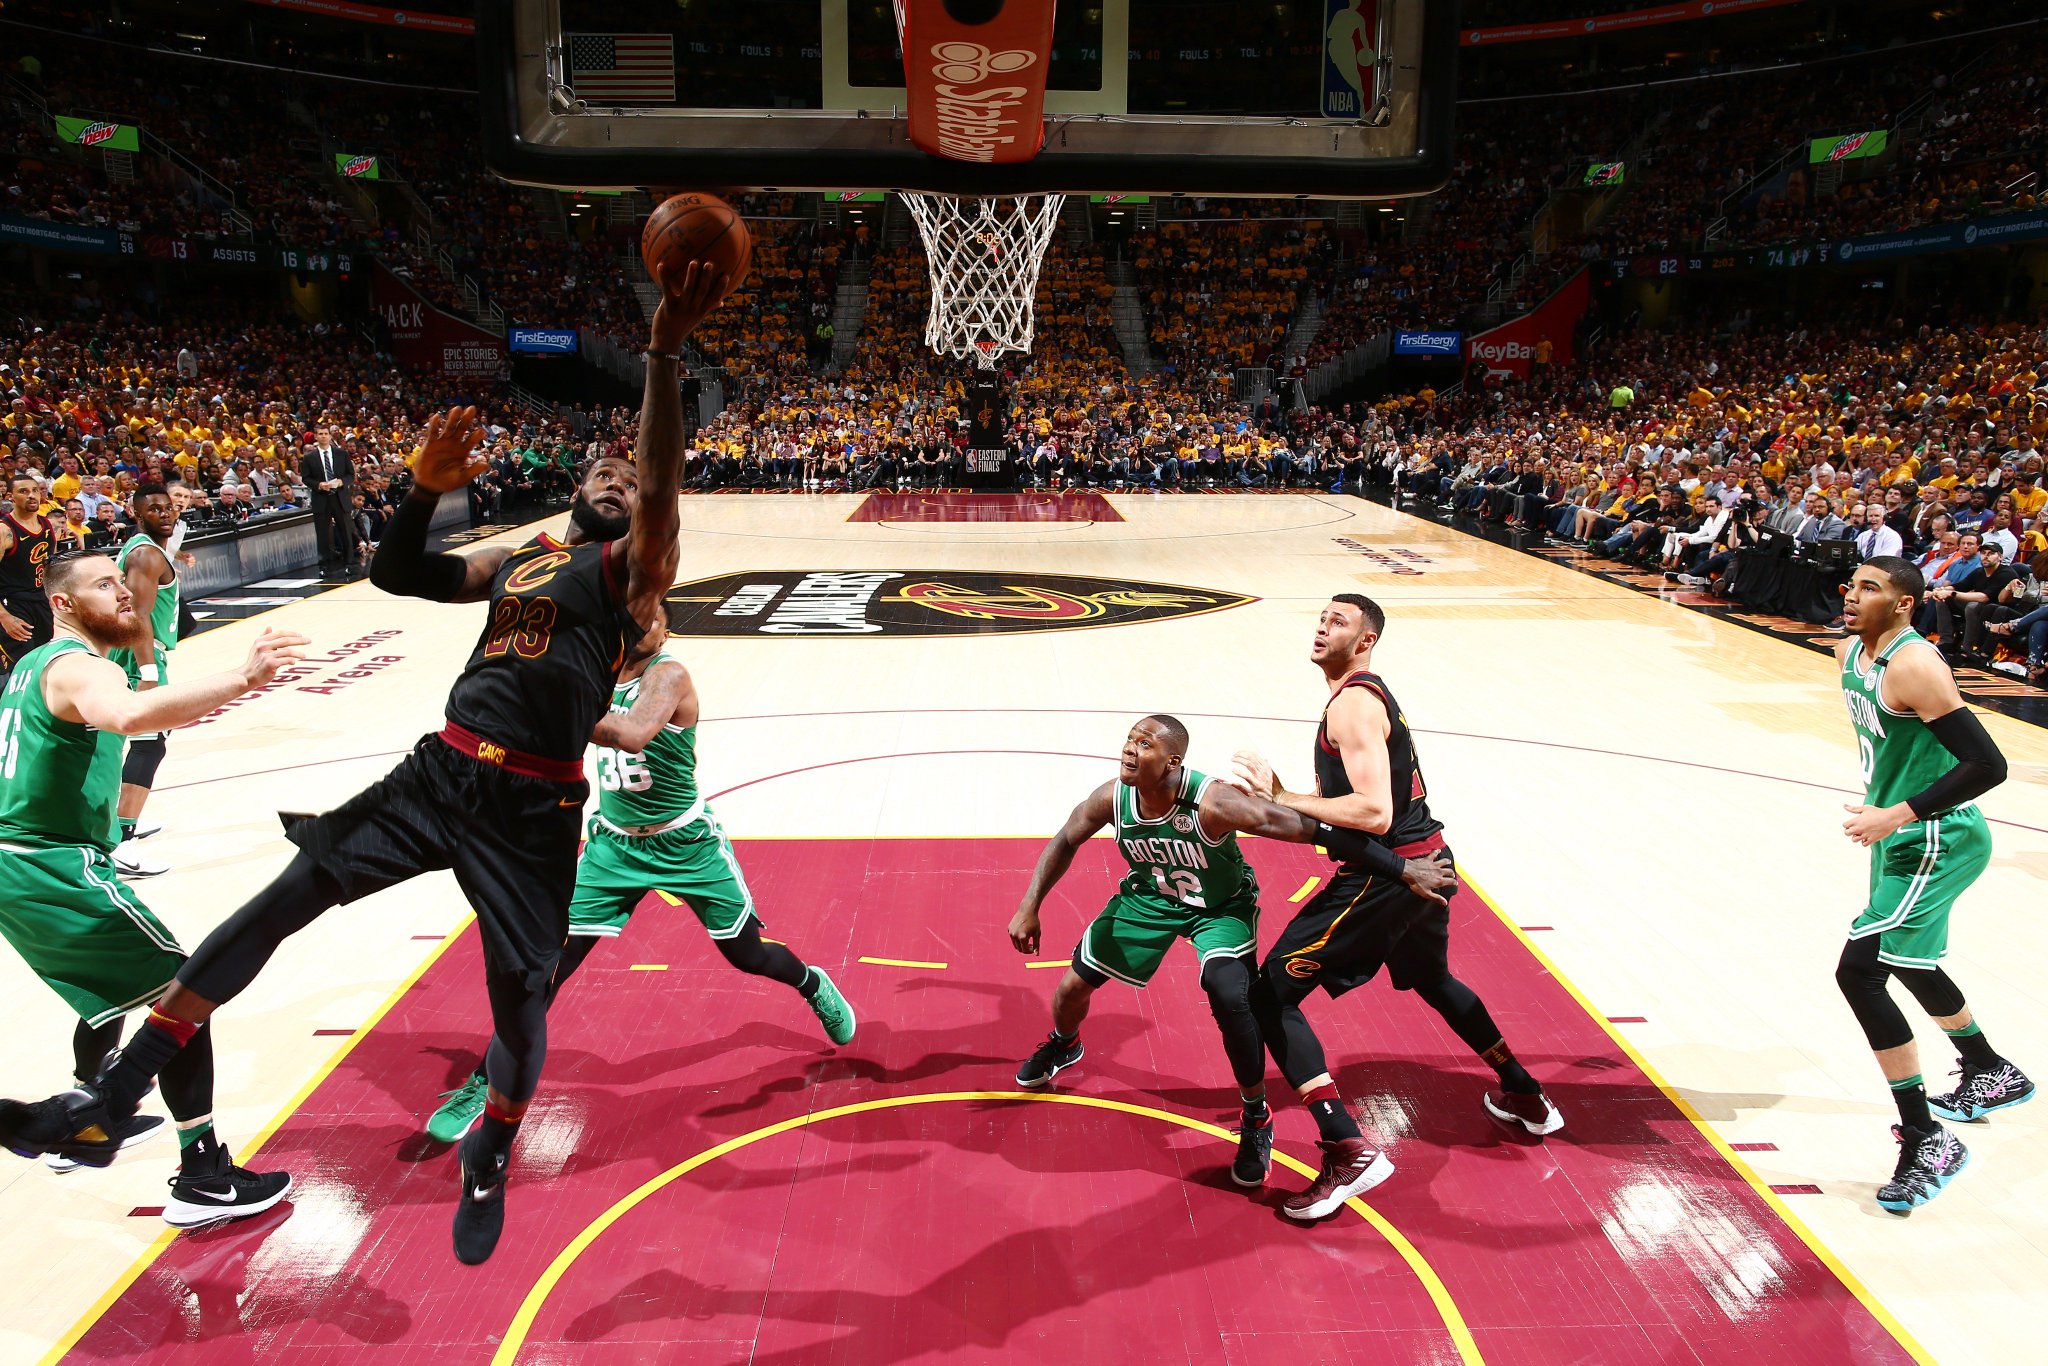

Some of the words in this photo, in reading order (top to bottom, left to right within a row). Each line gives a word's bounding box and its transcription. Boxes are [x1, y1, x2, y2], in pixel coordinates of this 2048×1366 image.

[740, 45, 771, 57] FOULS
[775, 46, 784, 58] 5
[801, 48, 822, 59] FG%
[1081, 49, 1097, 61] 74
[1179, 49, 1209, 60] FOULS
[1214, 49, 1223, 60] 5
[1328, 92, 1354, 113] NBA
[1, 223, 26, 234] ROCKET
[26, 227, 60, 240] MORTGAGE
[1979, 226, 2006, 236] ROCKET
[2006, 220, 2044, 233] MORTGAGE
[120, 242, 134, 254] 58
[171, 240, 188, 259] 13
[1854, 243, 1881, 253] ROCKET
[1881, 239, 1913, 250] MORTGAGE
[213, 248, 257, 262] ASSISTS
[281, 251, 298, 268] 16
[1711, 256, 1736, 269] 2:02
[1767, 249, 1784, 267] 74
[1819, 250, 1827, 263] 5
[338, 261, 351, 272] 40
[1659, 258, 1678, 274] 82
[1688, 258, 1702, 270] 30
[1616, 267, 1624, 279] 5
[515, 331, 573, 346] FirstEnergy
[1400, 334, 1457, 347] FirstEnergy
[443, 349, 462, 360] EPIC
[464, 348, 498, 360] STORIES
[444, 361, 464, 370] NEVER
[465, 361, 482, 370] START
[978, 449, 1007, 461] EASTERN
[978, 460, 1000, 472] FINALS
[678, 487, 973, 495] LEVELAND
[256, 533, 318, 573] NBATickets.co
[758, 572, 906, 634] CAVALIERS
[484, 596, 558, 659] 23
[298, 629, 404, 663] Loans
[296, 655, 408, 696] Arena
[1843, 688, 1887, 739] OSTON
[477, 742, 506, 765] CAVS
[597, 746, 654, 792] 36
[1122, 838, 1209, 870] BOSTON
[1151, 866, 1207, 909] 12
